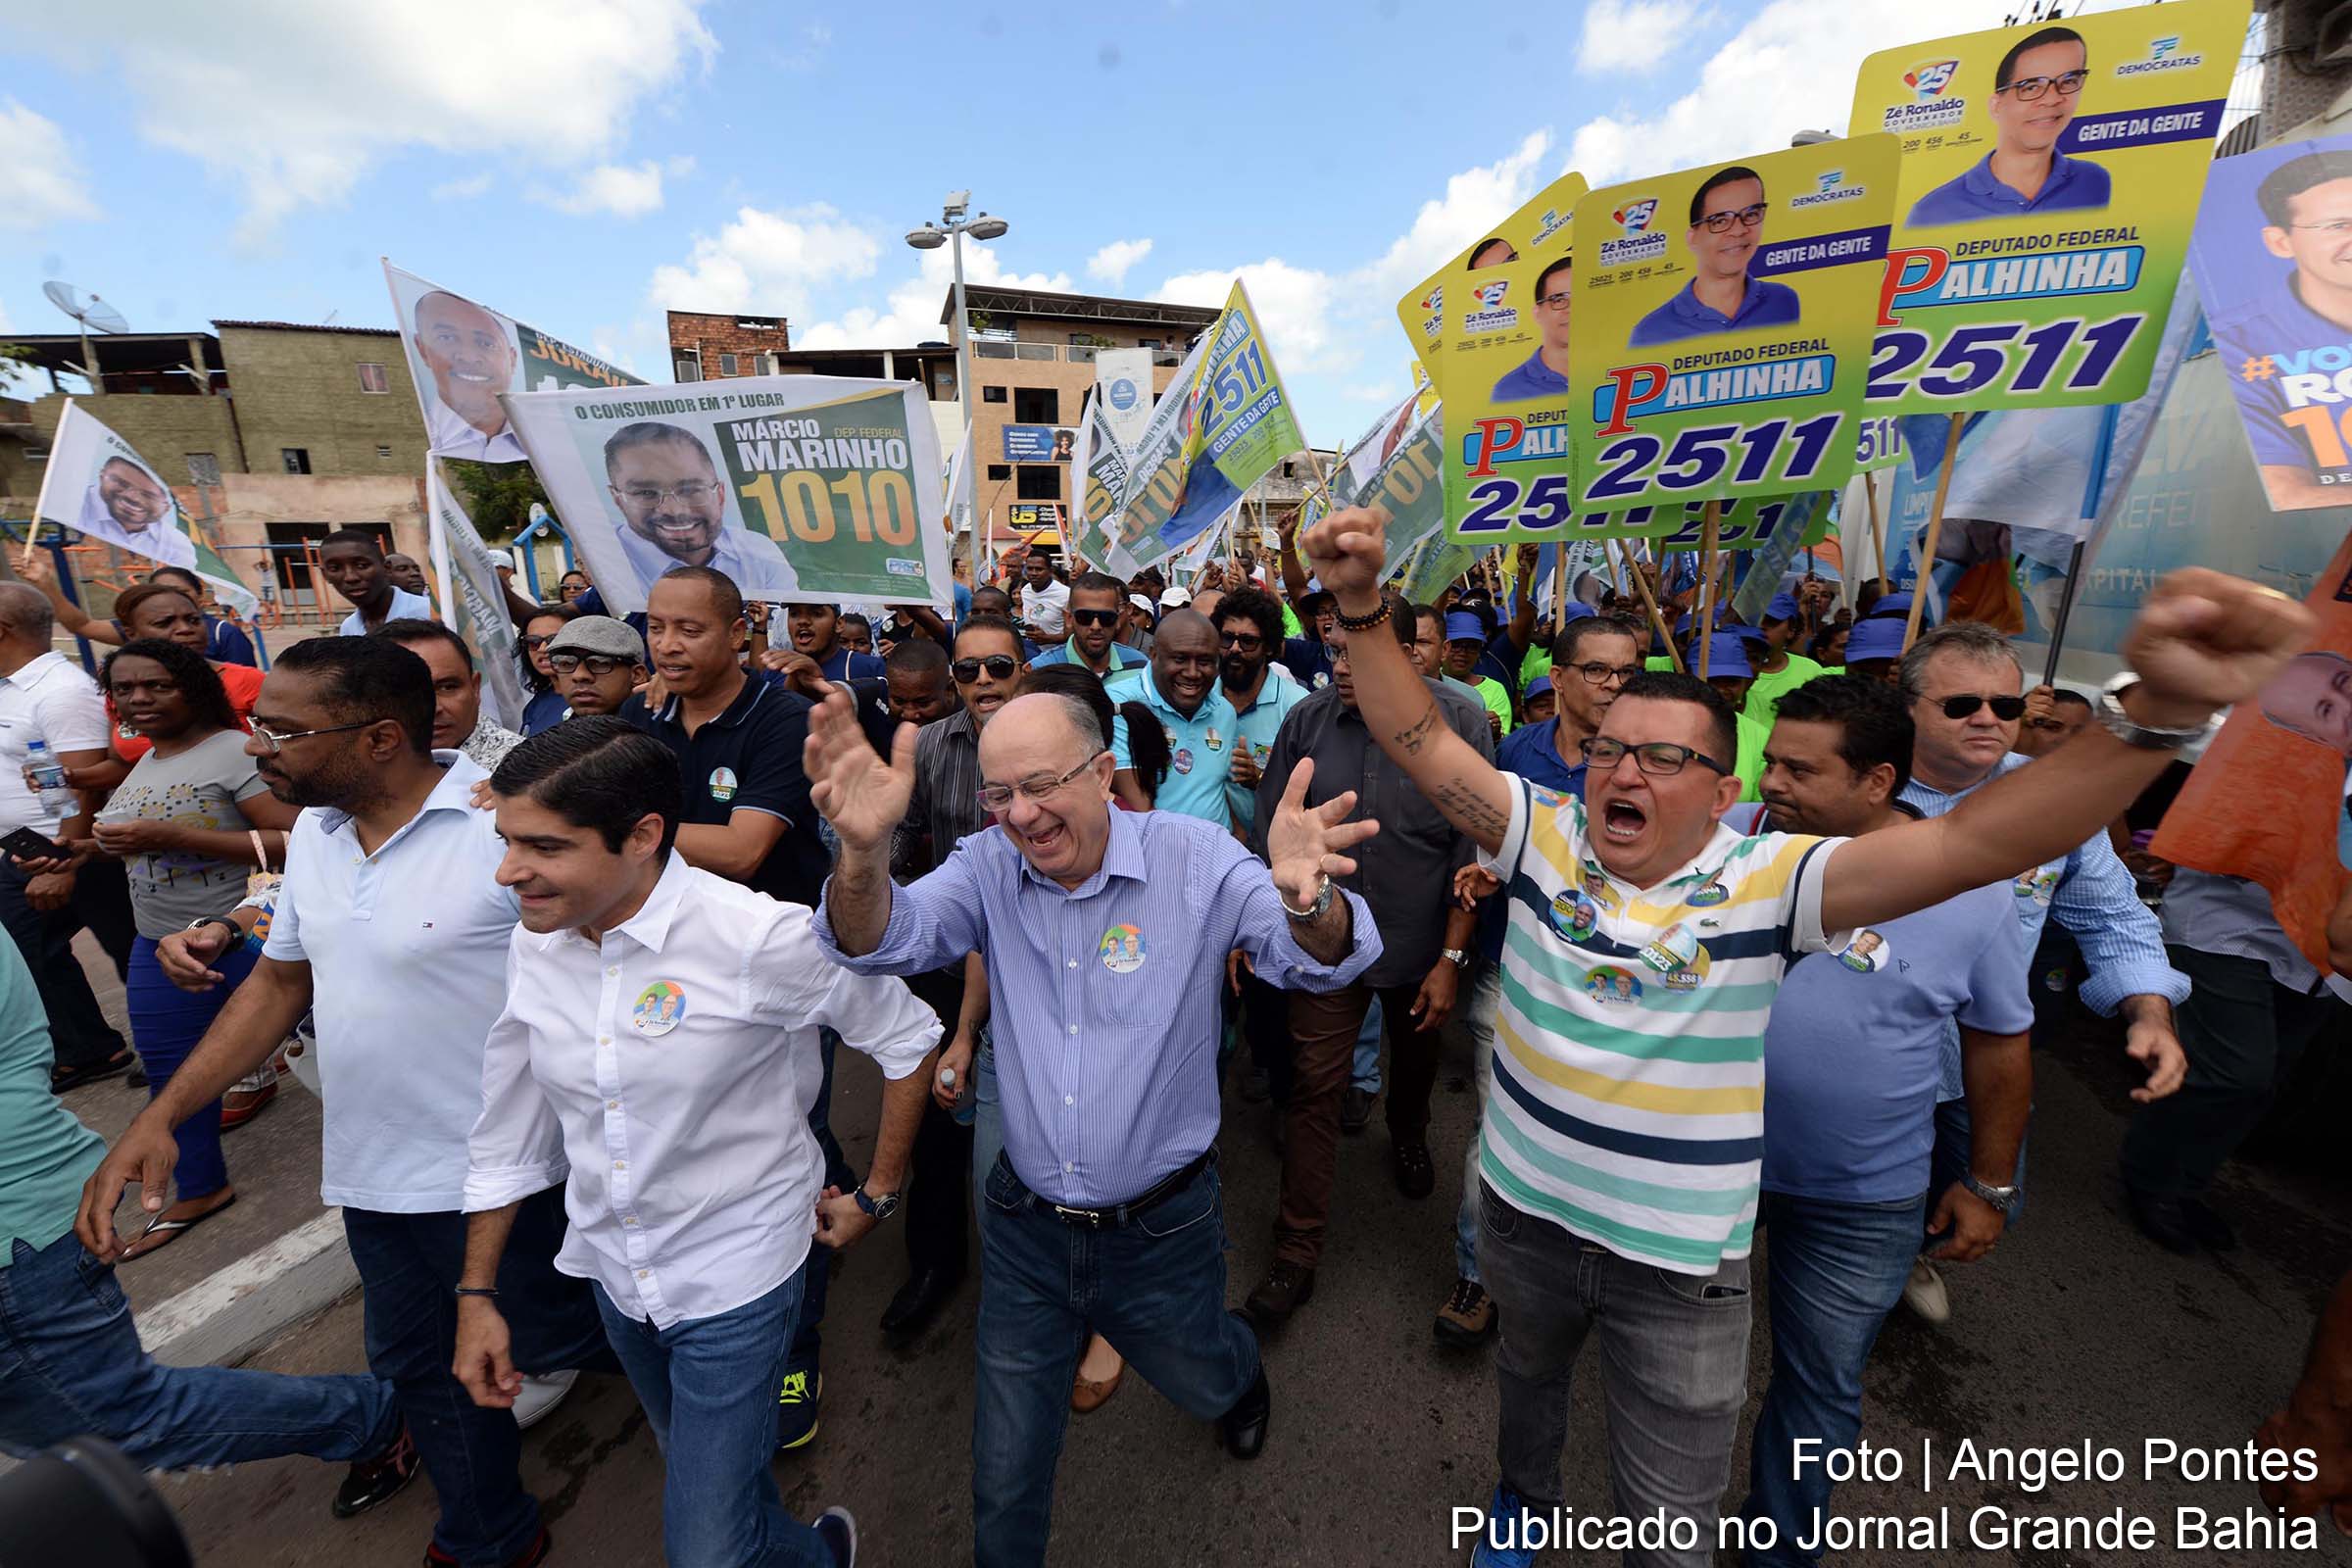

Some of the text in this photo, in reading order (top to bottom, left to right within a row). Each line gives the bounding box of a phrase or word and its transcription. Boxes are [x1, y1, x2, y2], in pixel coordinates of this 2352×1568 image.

[2117, 56, 2201, 75] DEMOCRATAS
[1886, 98, 1965, 120] Zé Ronaldo
[2078, 111, 2204, 142] GENTE DA GENTE
[1791, 187, 1864, 207] DEMOCRATAS
[1600, 233, 1666, 253] Zé Ronaldo
[1765, 236, 1872, 267] GENTE DA GENTE
[1956, 226, 2140, 256] DEPUTADO FEDERAL
[1674, 338, 1831, 370] DEPUTADO FEDERAL
[1864, 316, 2144, 401] 2511
[1200, 339, 1266, 438] 2511
[1594, 363, 1825, 439] PALHINHA
[574, 406, 589, 419] O
[590, 398, 697, 418] CONSUMIDOR
[700, 395, 720, 411] EM
[740, 392, 785, 409] LUGAR
[1528, 410, 1568, 423] DEPUT
[730, 418, 820, 441] MÁRCIO
[859, 427, 905, 438] FEDERAL
[1213, 417, 1250, 453] GENTE
[1247, 405, 1261, 423] DA
[736, 439, 908, 471] MARINHO
[1584, 412, 1846, 502] 2511
[740, 470, 917, 546] 1010
